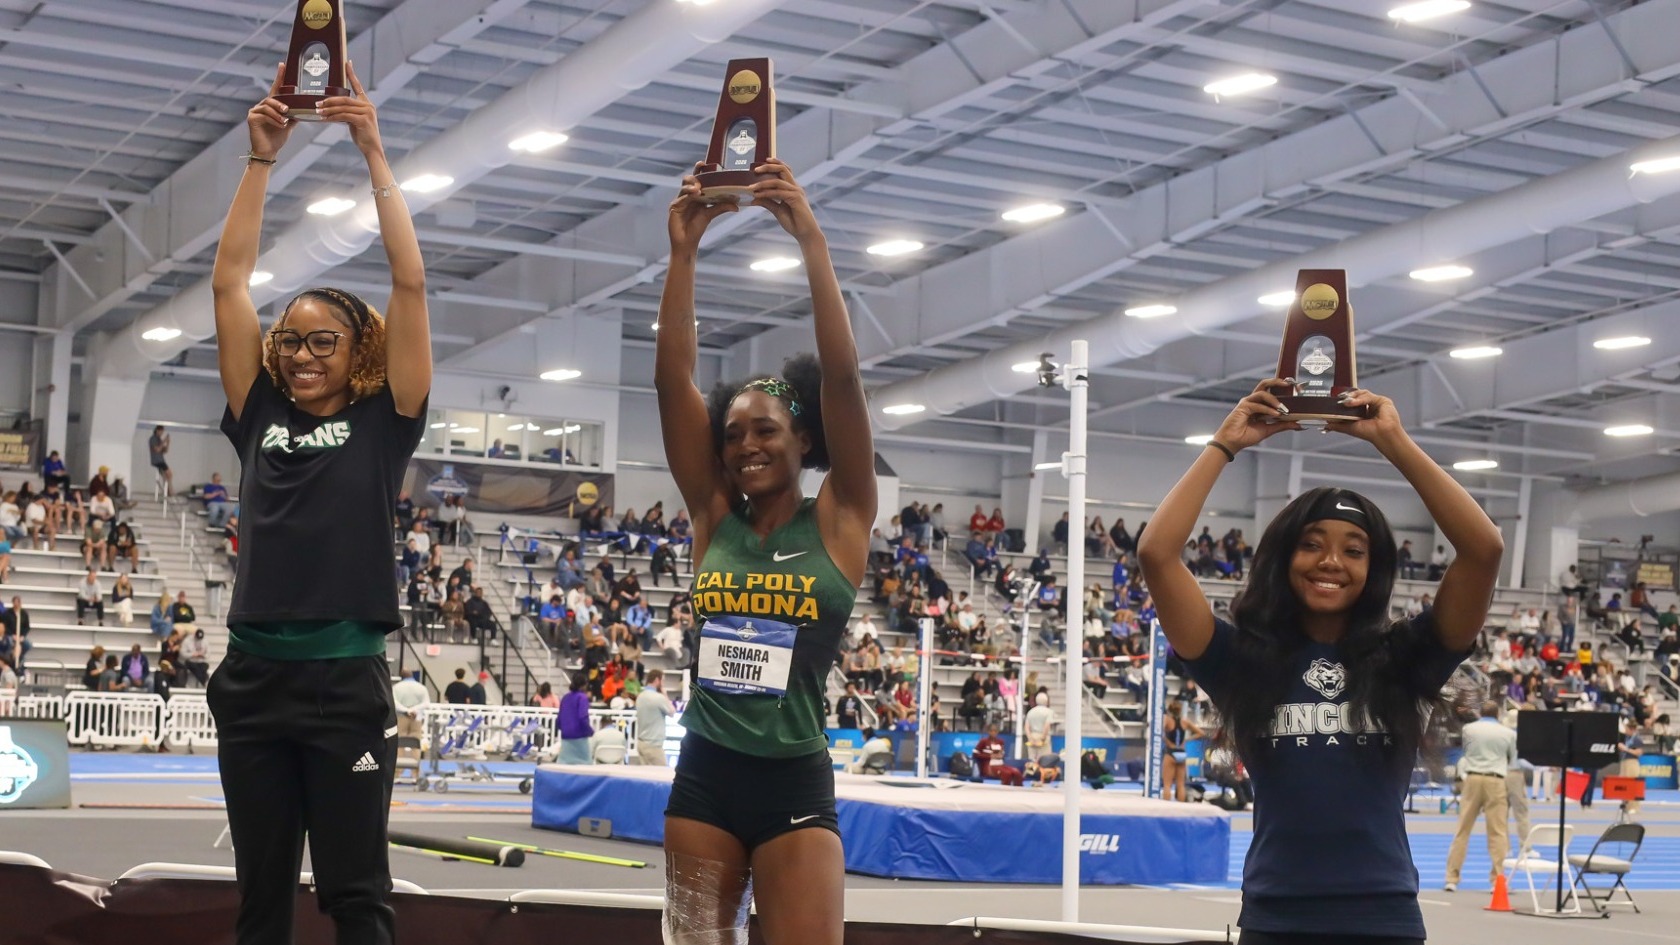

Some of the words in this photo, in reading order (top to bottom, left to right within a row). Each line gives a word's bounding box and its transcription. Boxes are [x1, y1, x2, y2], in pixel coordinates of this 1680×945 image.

[696, 571, 740, 590] CAL
[746, 573, 817, 594] POLY
[693, 591, 819, 621] POMONA
[717, 644, 769, 664] NESHARA
[720, 660, 763, 682] SMITH
[1590, 743, 1616, 754] GILL
[352, 763, 380, 772] adidas
[1079, 833, 1120, 852] GILL
